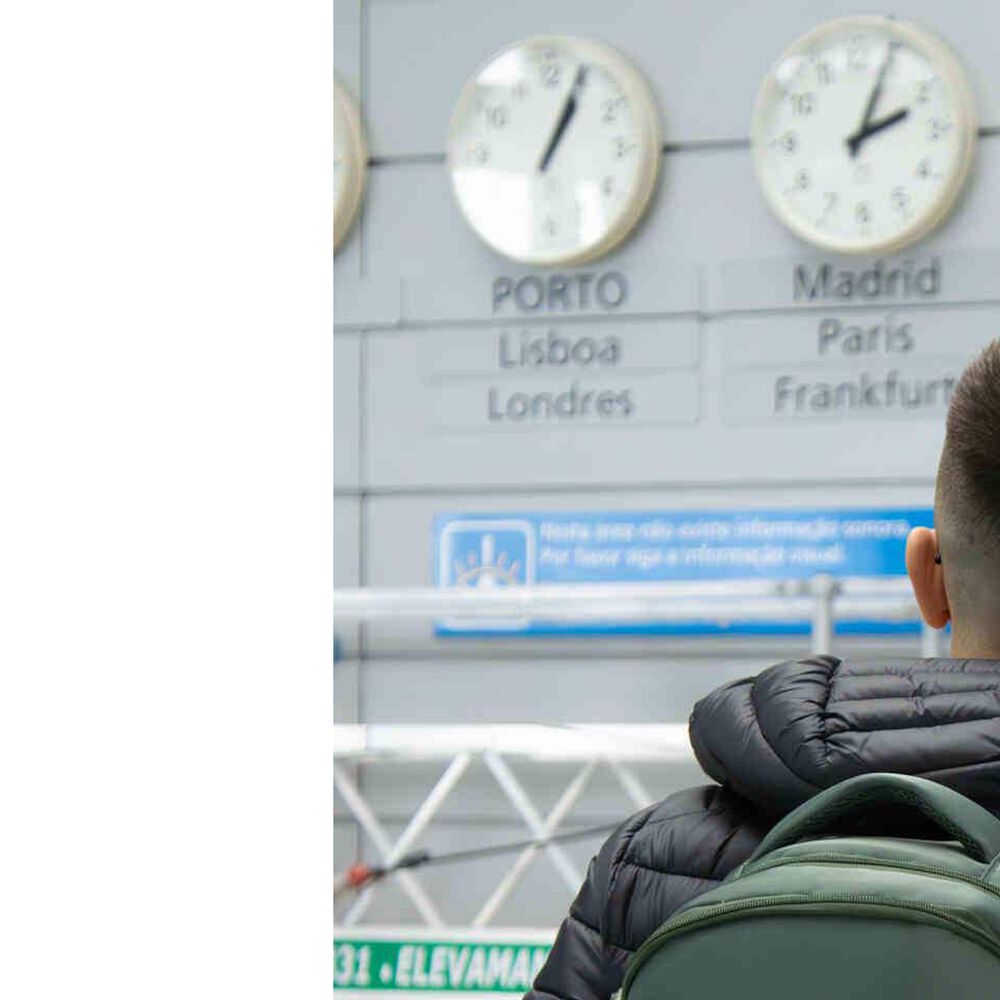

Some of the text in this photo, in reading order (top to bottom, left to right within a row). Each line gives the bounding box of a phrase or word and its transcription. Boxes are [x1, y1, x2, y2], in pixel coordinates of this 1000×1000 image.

[491, 271, 629, 314] PORTO
[792, 260, 942, 302] Madrid
[498, 328, 622, 369] Lisboa
[818, 313, 915, 355] Paris
[487, 384, 636, 422] Londres
